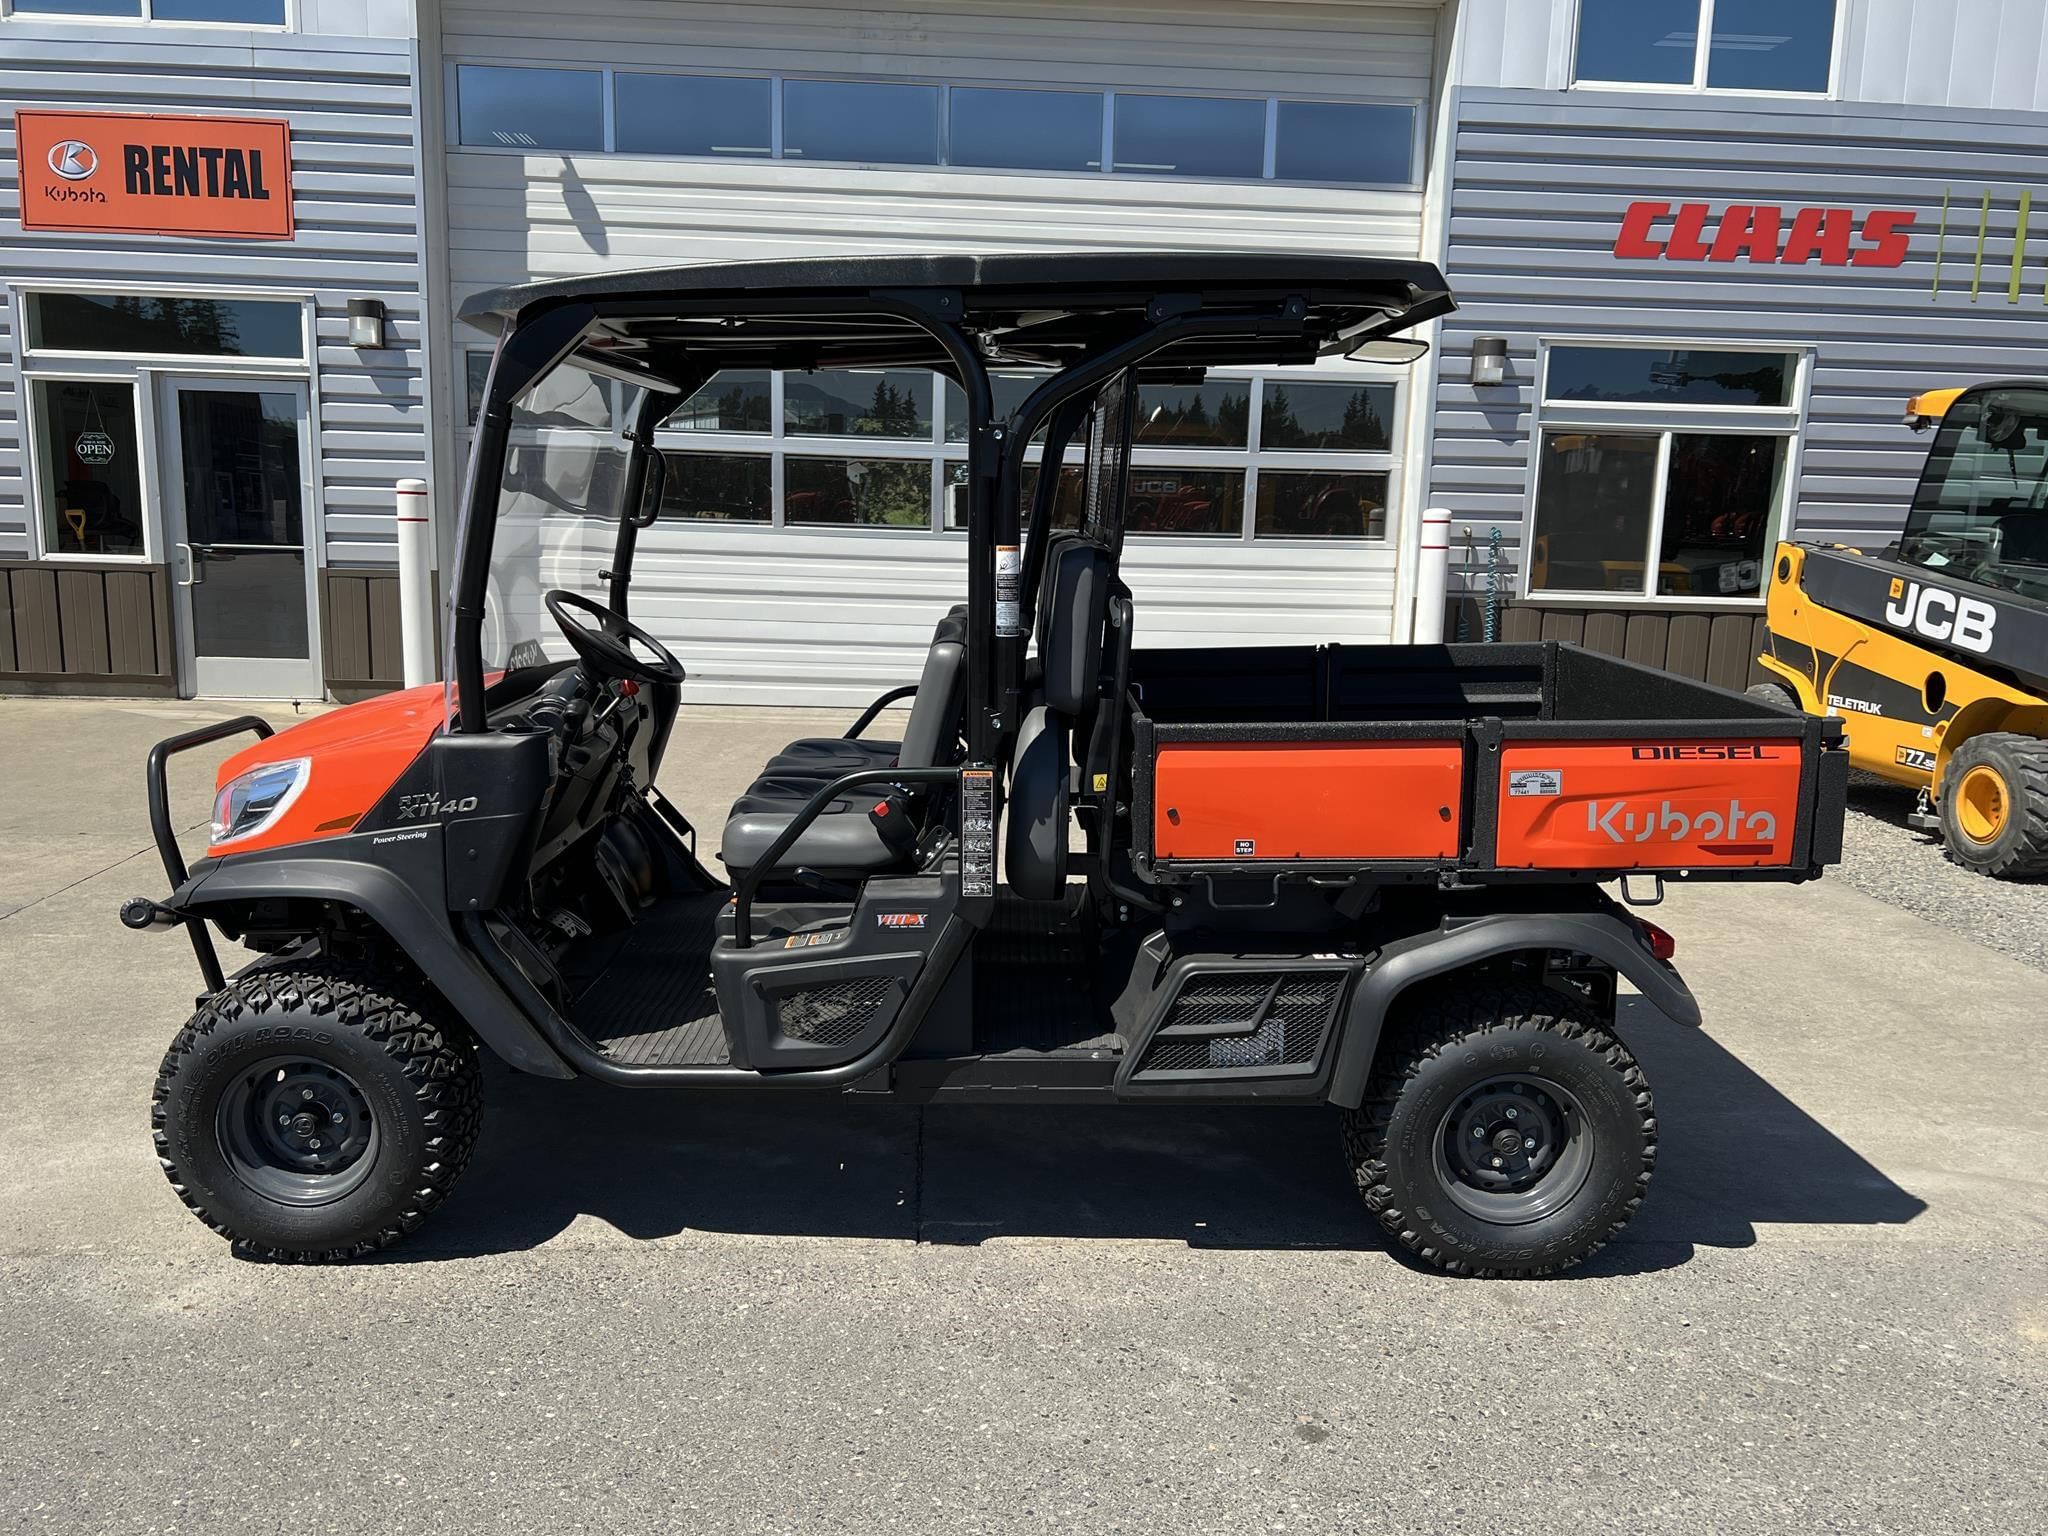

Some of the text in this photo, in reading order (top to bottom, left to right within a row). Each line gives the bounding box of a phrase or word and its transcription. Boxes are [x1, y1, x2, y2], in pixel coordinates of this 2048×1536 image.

[123, 144, 270, 200] RENTAL
[45, 186, 106, 203] Kubota
[1613, 202, 1917, 268] CLAAS
[77, 443, 112, 455] OPEN
[1885, 582, 1997, 653] JCB
[1828, 695, 1882, 716] TELETRUK
[1632, 746, 1780, 760] DIESEL
[397, 796, 478, 820] X1140
[399, 792, 440, 805] RTV
[1587, 800, 1776, 842] Kubota
[373, 831, 428, 844] Power Steering
[207, 1032, 249, 1066] OFF
[256, 1026, 335, 1045] ROAD
